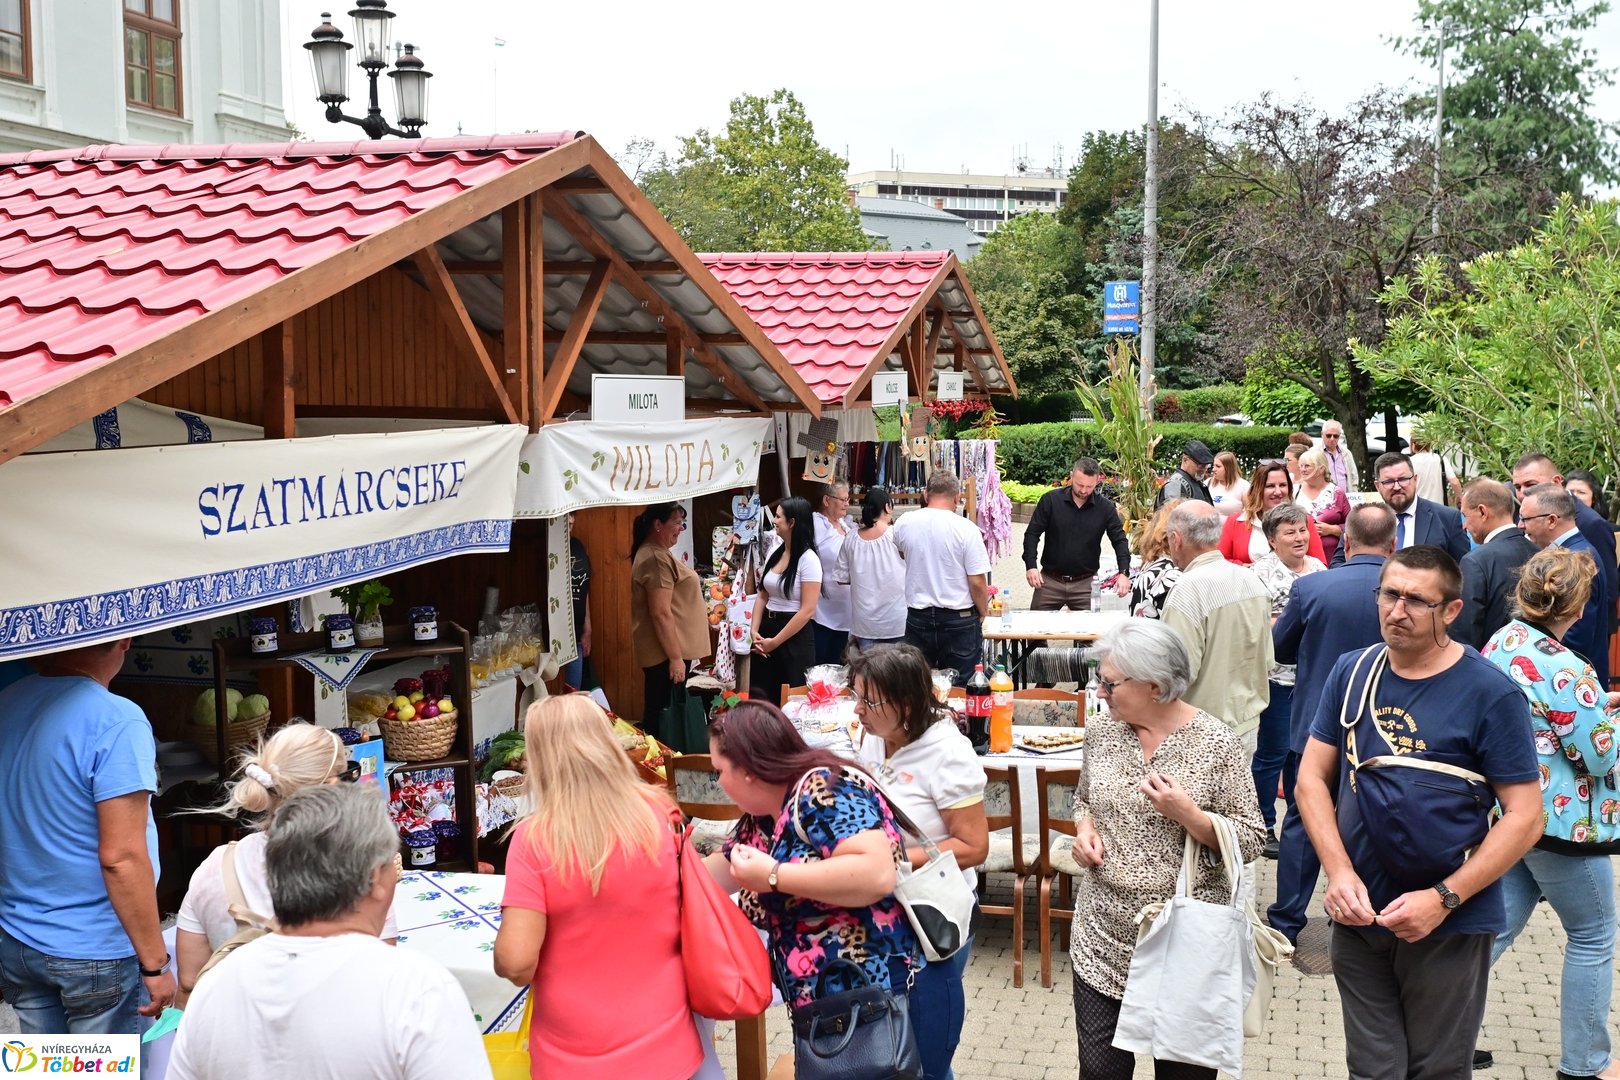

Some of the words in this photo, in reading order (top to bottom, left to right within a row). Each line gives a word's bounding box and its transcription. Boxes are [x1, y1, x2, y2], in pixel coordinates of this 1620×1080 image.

[628, 393, 659, 410] MILOTA
[610, 440, 714, 491] MILOTA
[199, 458, 466, 540] SZATMÁRCSEKE
[1392, 707, 1405, 717] DRY
[1404, 714, 1417, 733] GOODS
